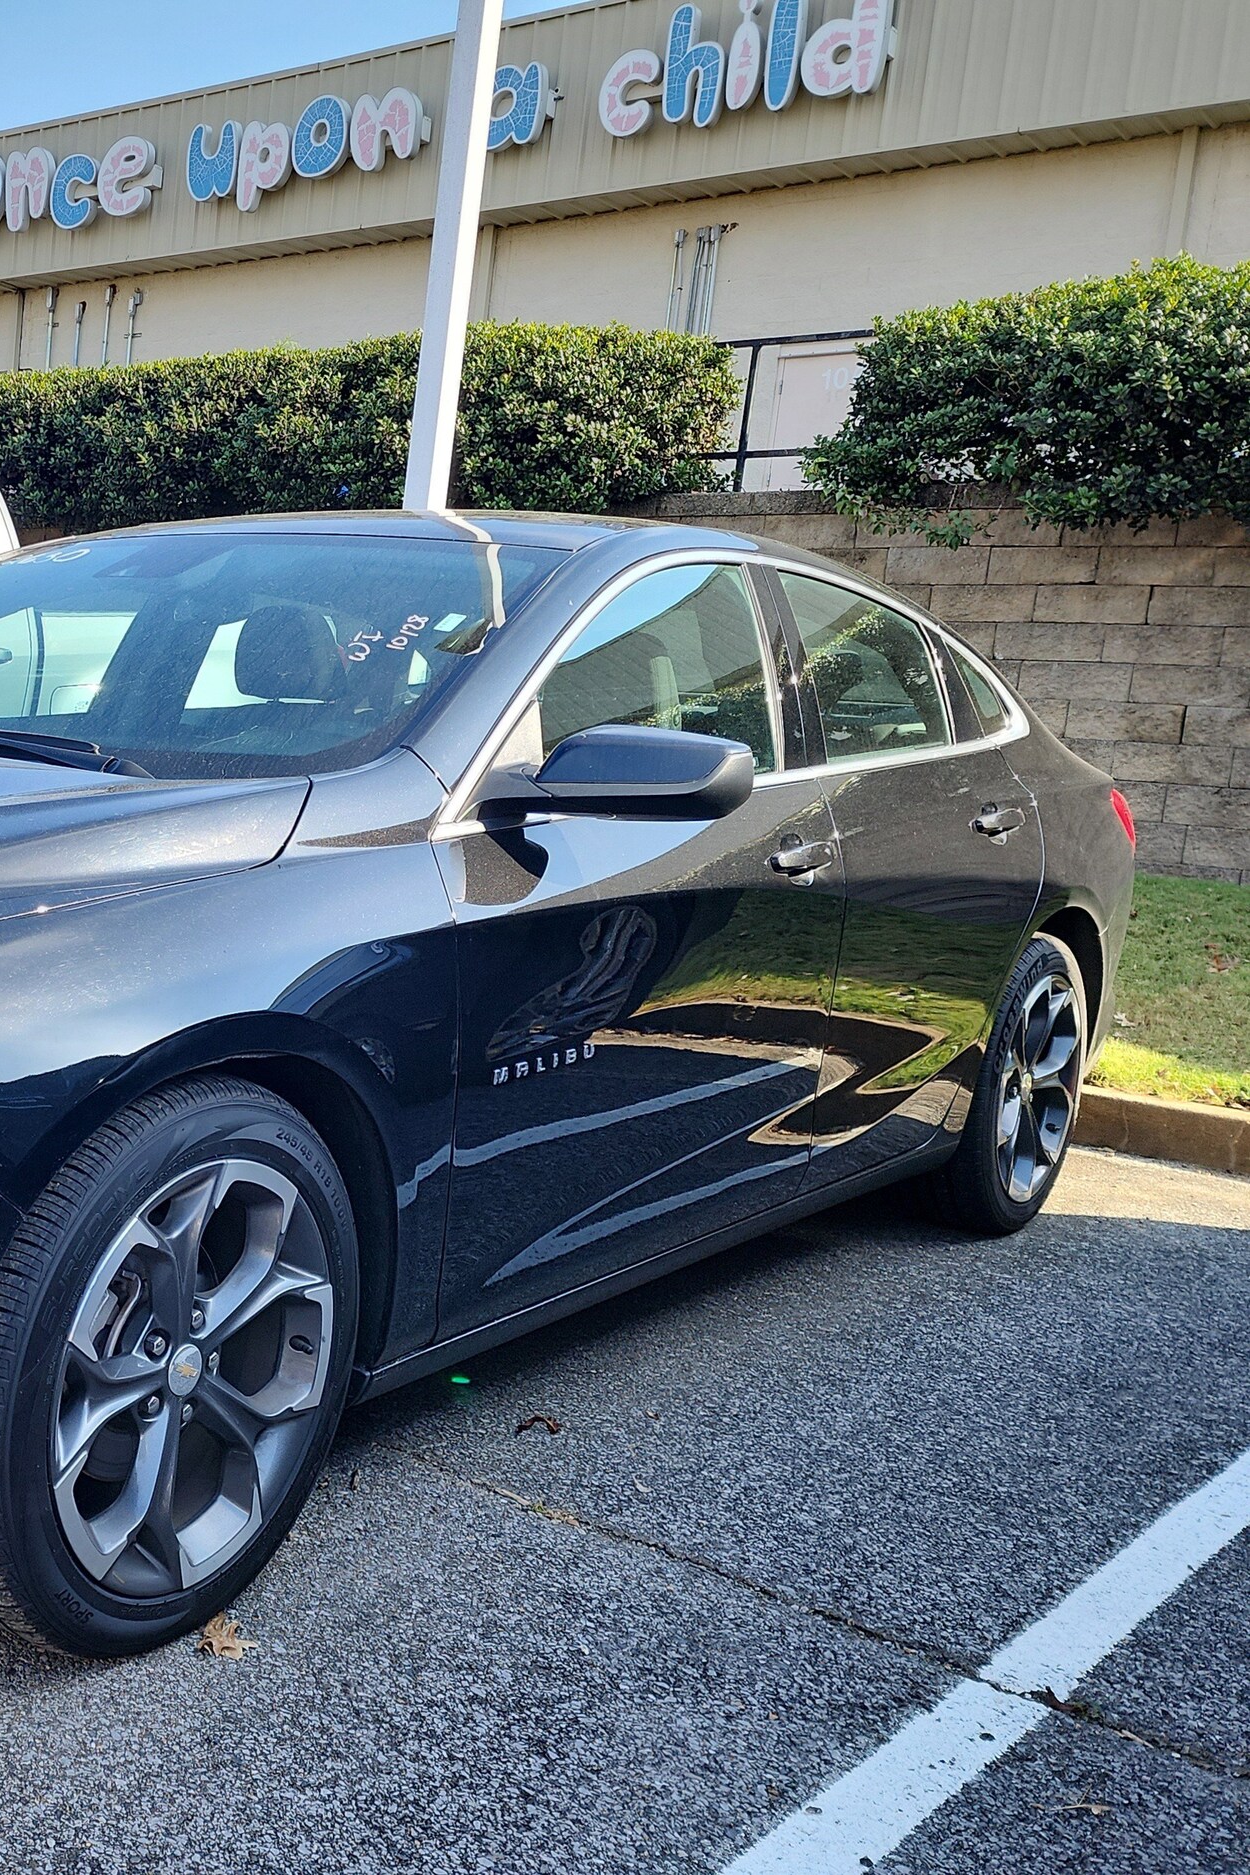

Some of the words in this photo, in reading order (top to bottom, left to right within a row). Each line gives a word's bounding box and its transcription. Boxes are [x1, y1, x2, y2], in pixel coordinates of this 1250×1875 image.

[186, 86, 426, 213] upon
[487, 61, 550, 152] a
[598, 0, 892, 140] child
[492, 1042, 596, 1086] MALIBU
[275, 1127, 313, 1163] 245/45
[313, 1159, 332, 1189] R18
[53, 1588, 95, 1625] SPORT
